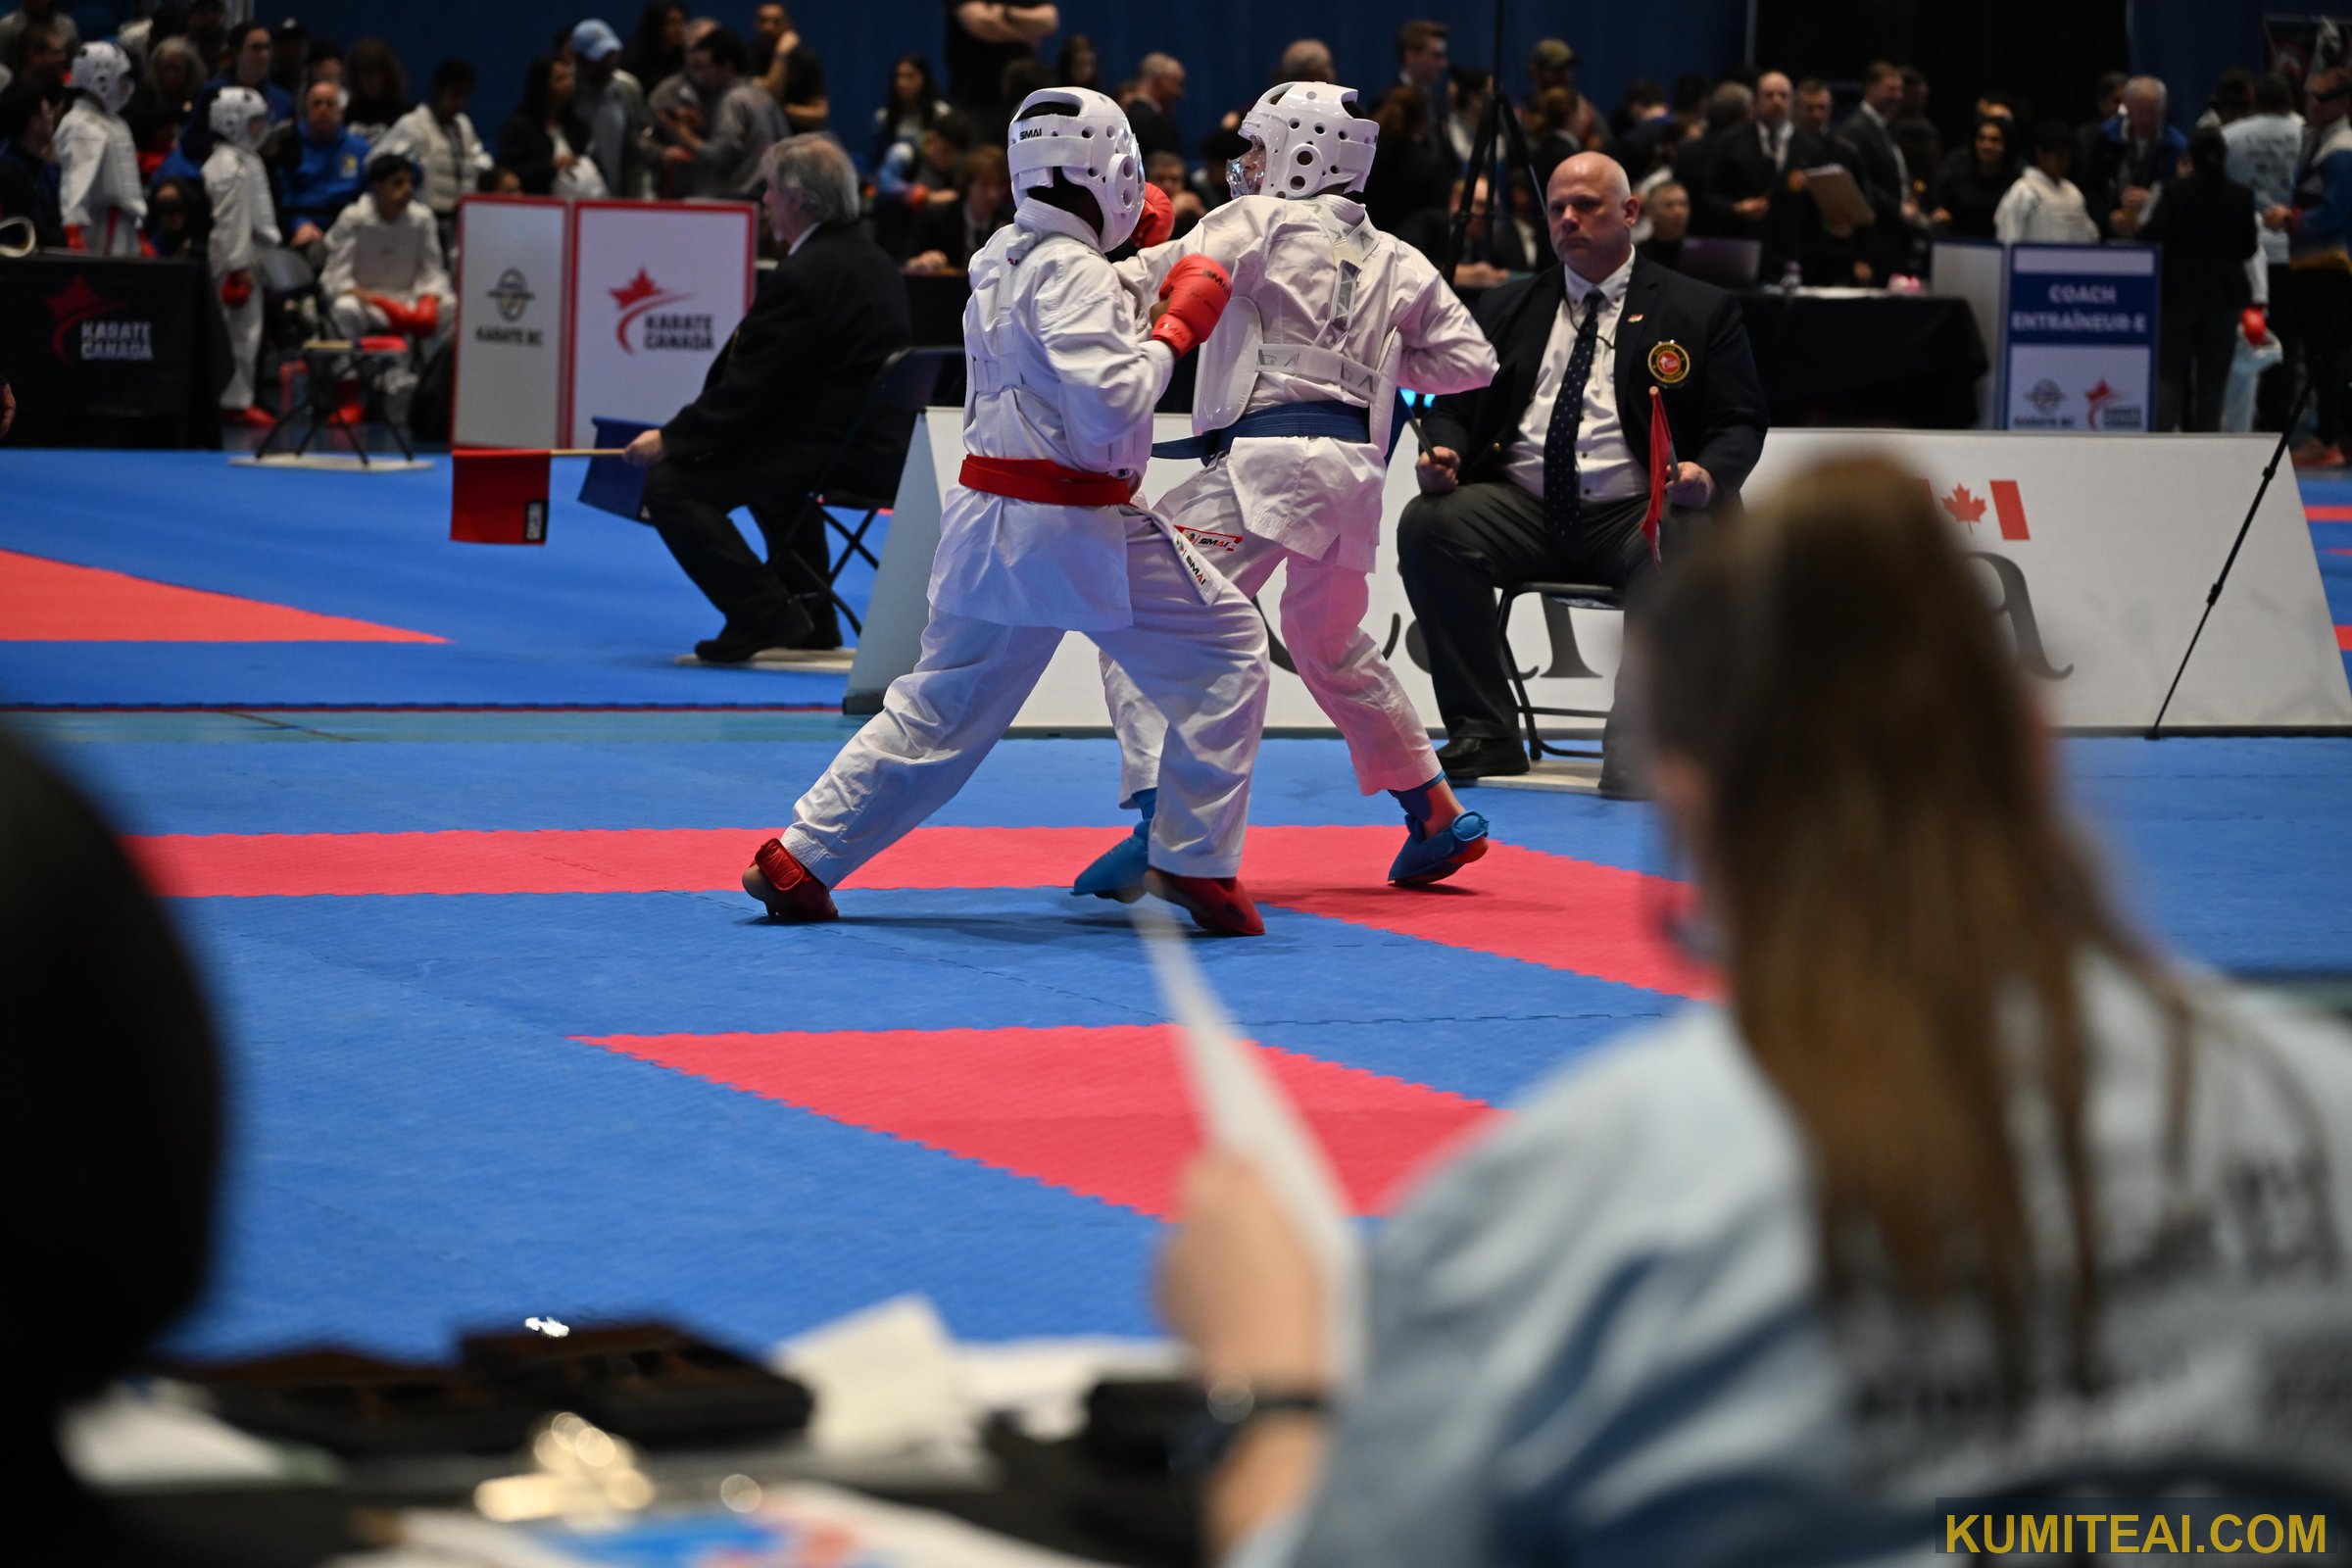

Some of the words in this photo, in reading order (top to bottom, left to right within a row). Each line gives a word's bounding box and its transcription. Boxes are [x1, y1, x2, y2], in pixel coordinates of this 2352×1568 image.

[1020, 128, 1043, 140] SMAI
[2048, 283, 2117, 304] COACH
[80, 320, 152, 340] KARATE
[644, 314, 712, 330] KARATE
[644, 332, 714, 350] CANADA
[80, 342, 154, 361] CANADA
[1199, 537, 1230, 548] SMAI
[1186, 555, 1206, 585] SMAI
